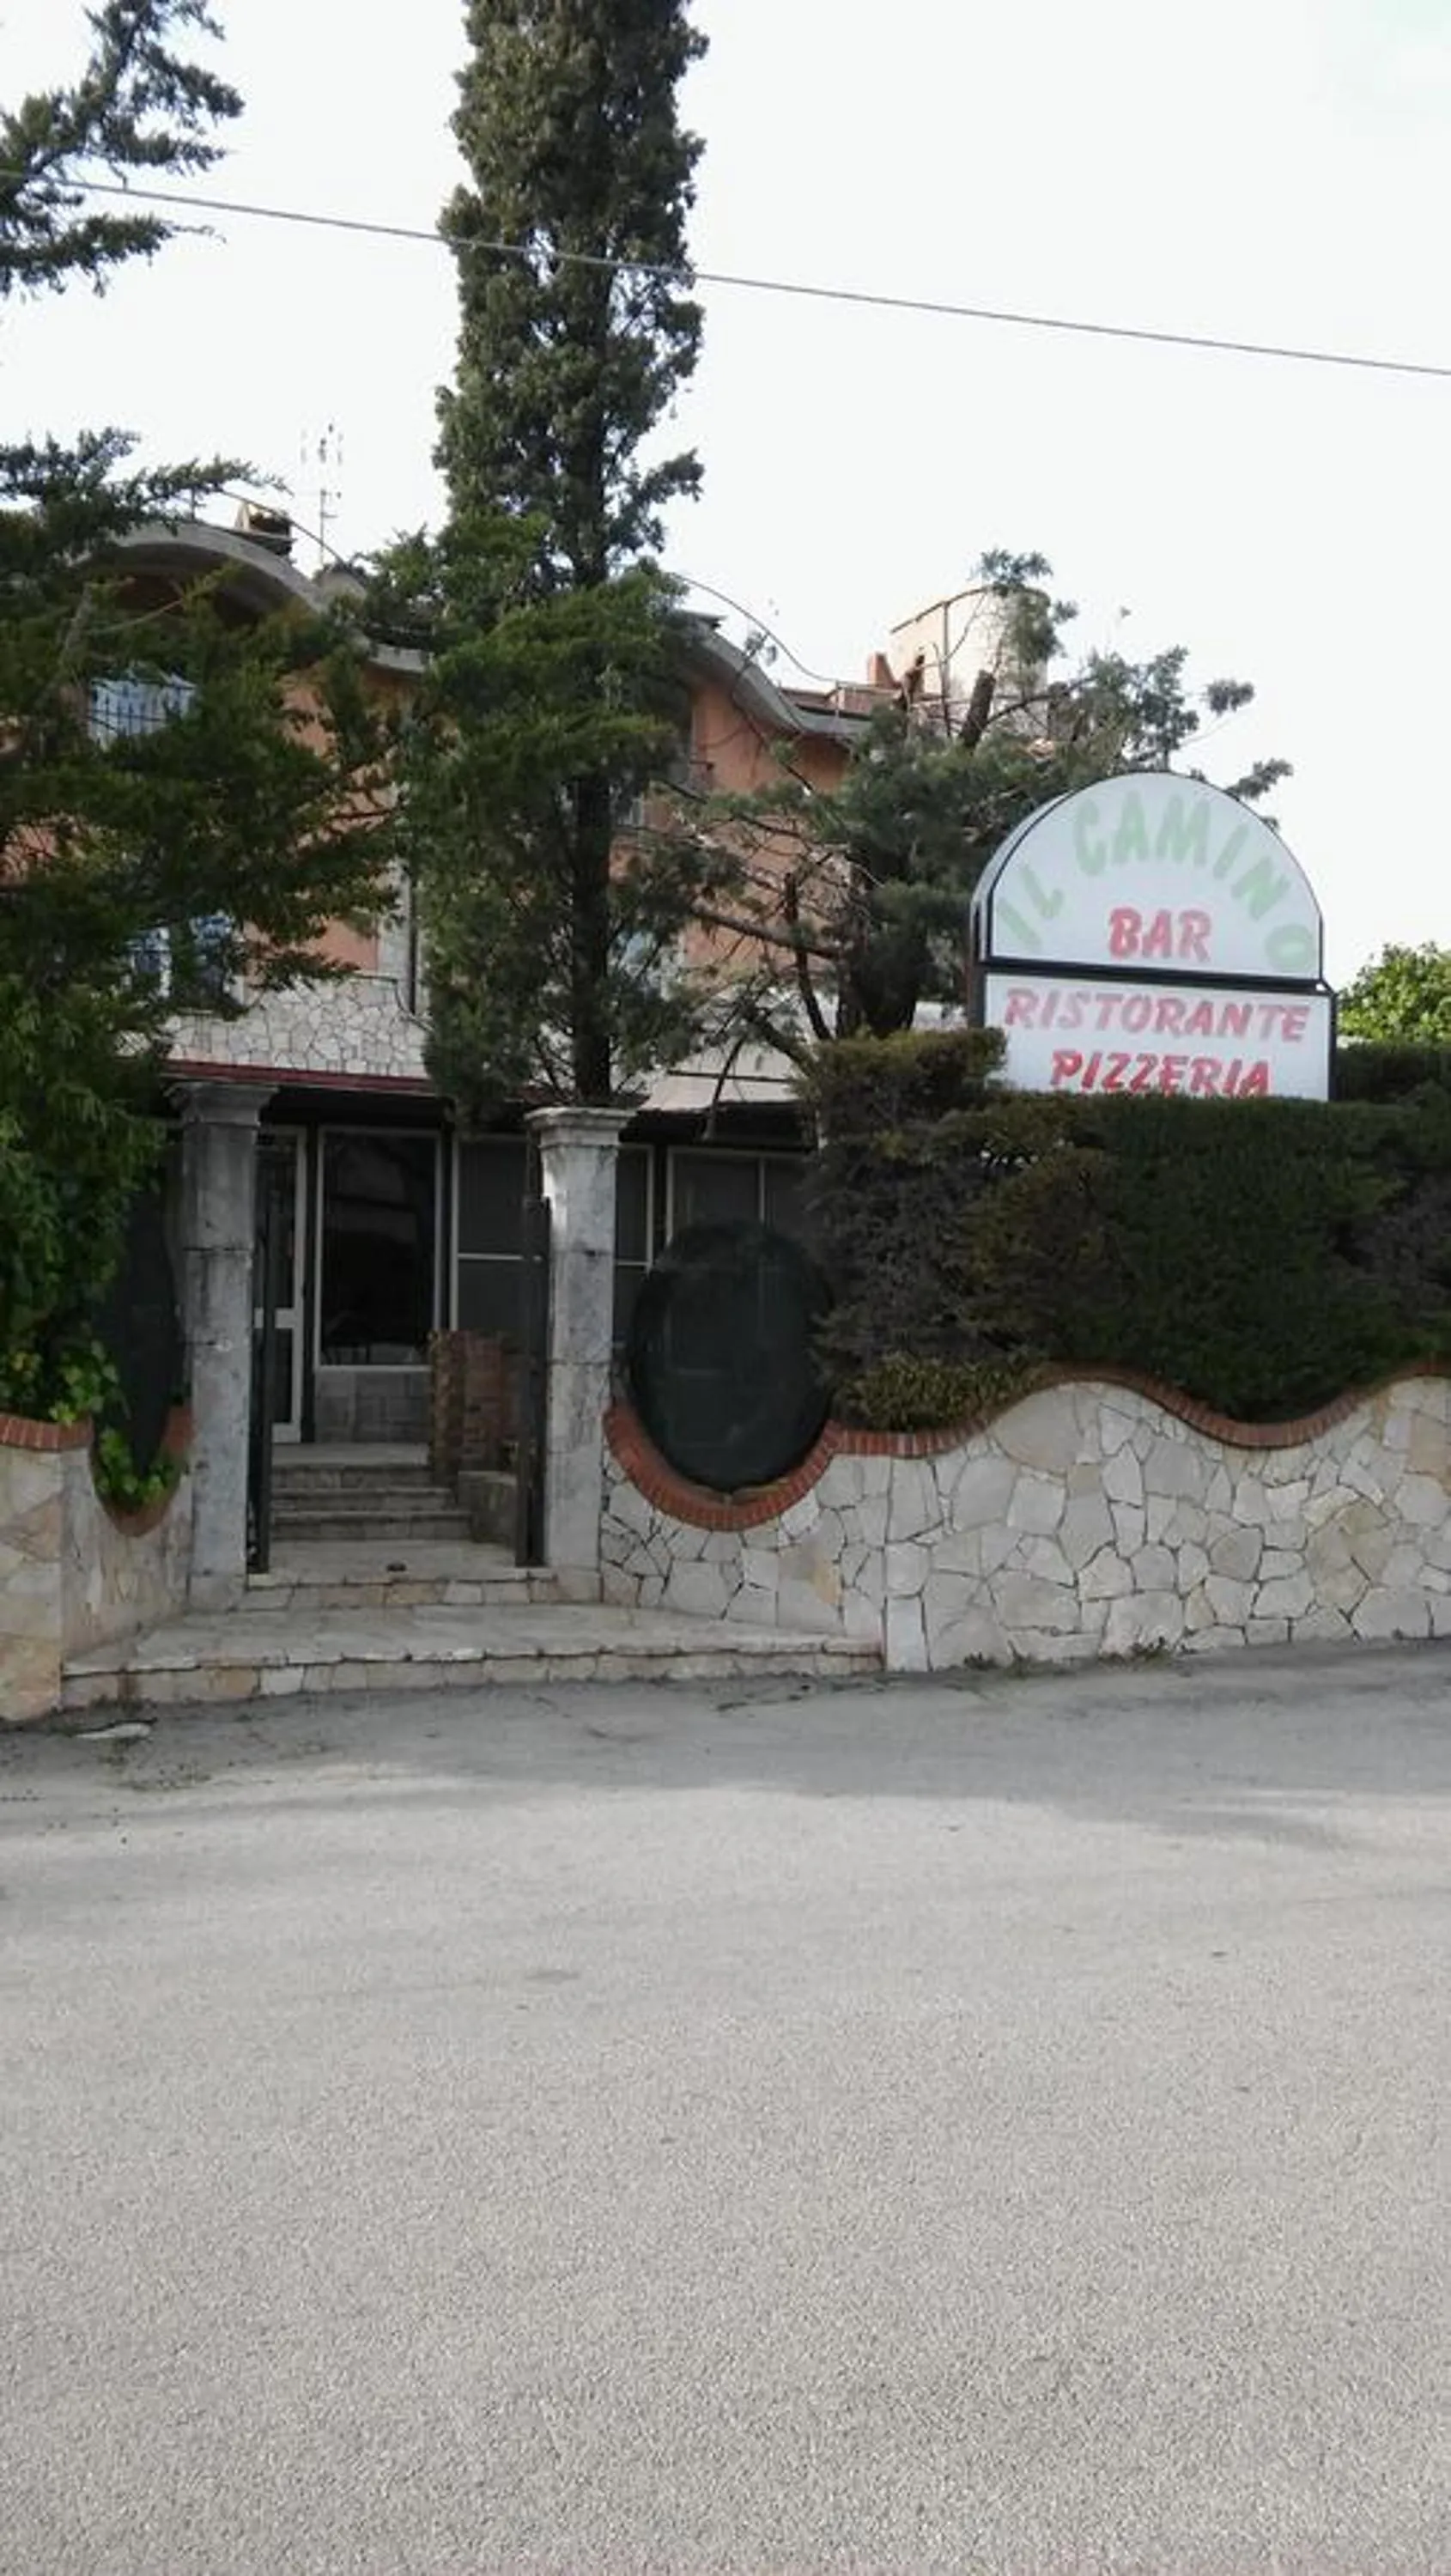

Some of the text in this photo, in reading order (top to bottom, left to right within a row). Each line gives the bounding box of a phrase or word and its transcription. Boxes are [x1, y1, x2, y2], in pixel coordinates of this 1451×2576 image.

[997, 790, 1317, 973] IL CAMINO
[1108, 906, 1212, 962] BAR
[1005, 987, 1310, 1042] RISTORANTE
[1050, 1049, 1272, 1097] PIZZERIA
